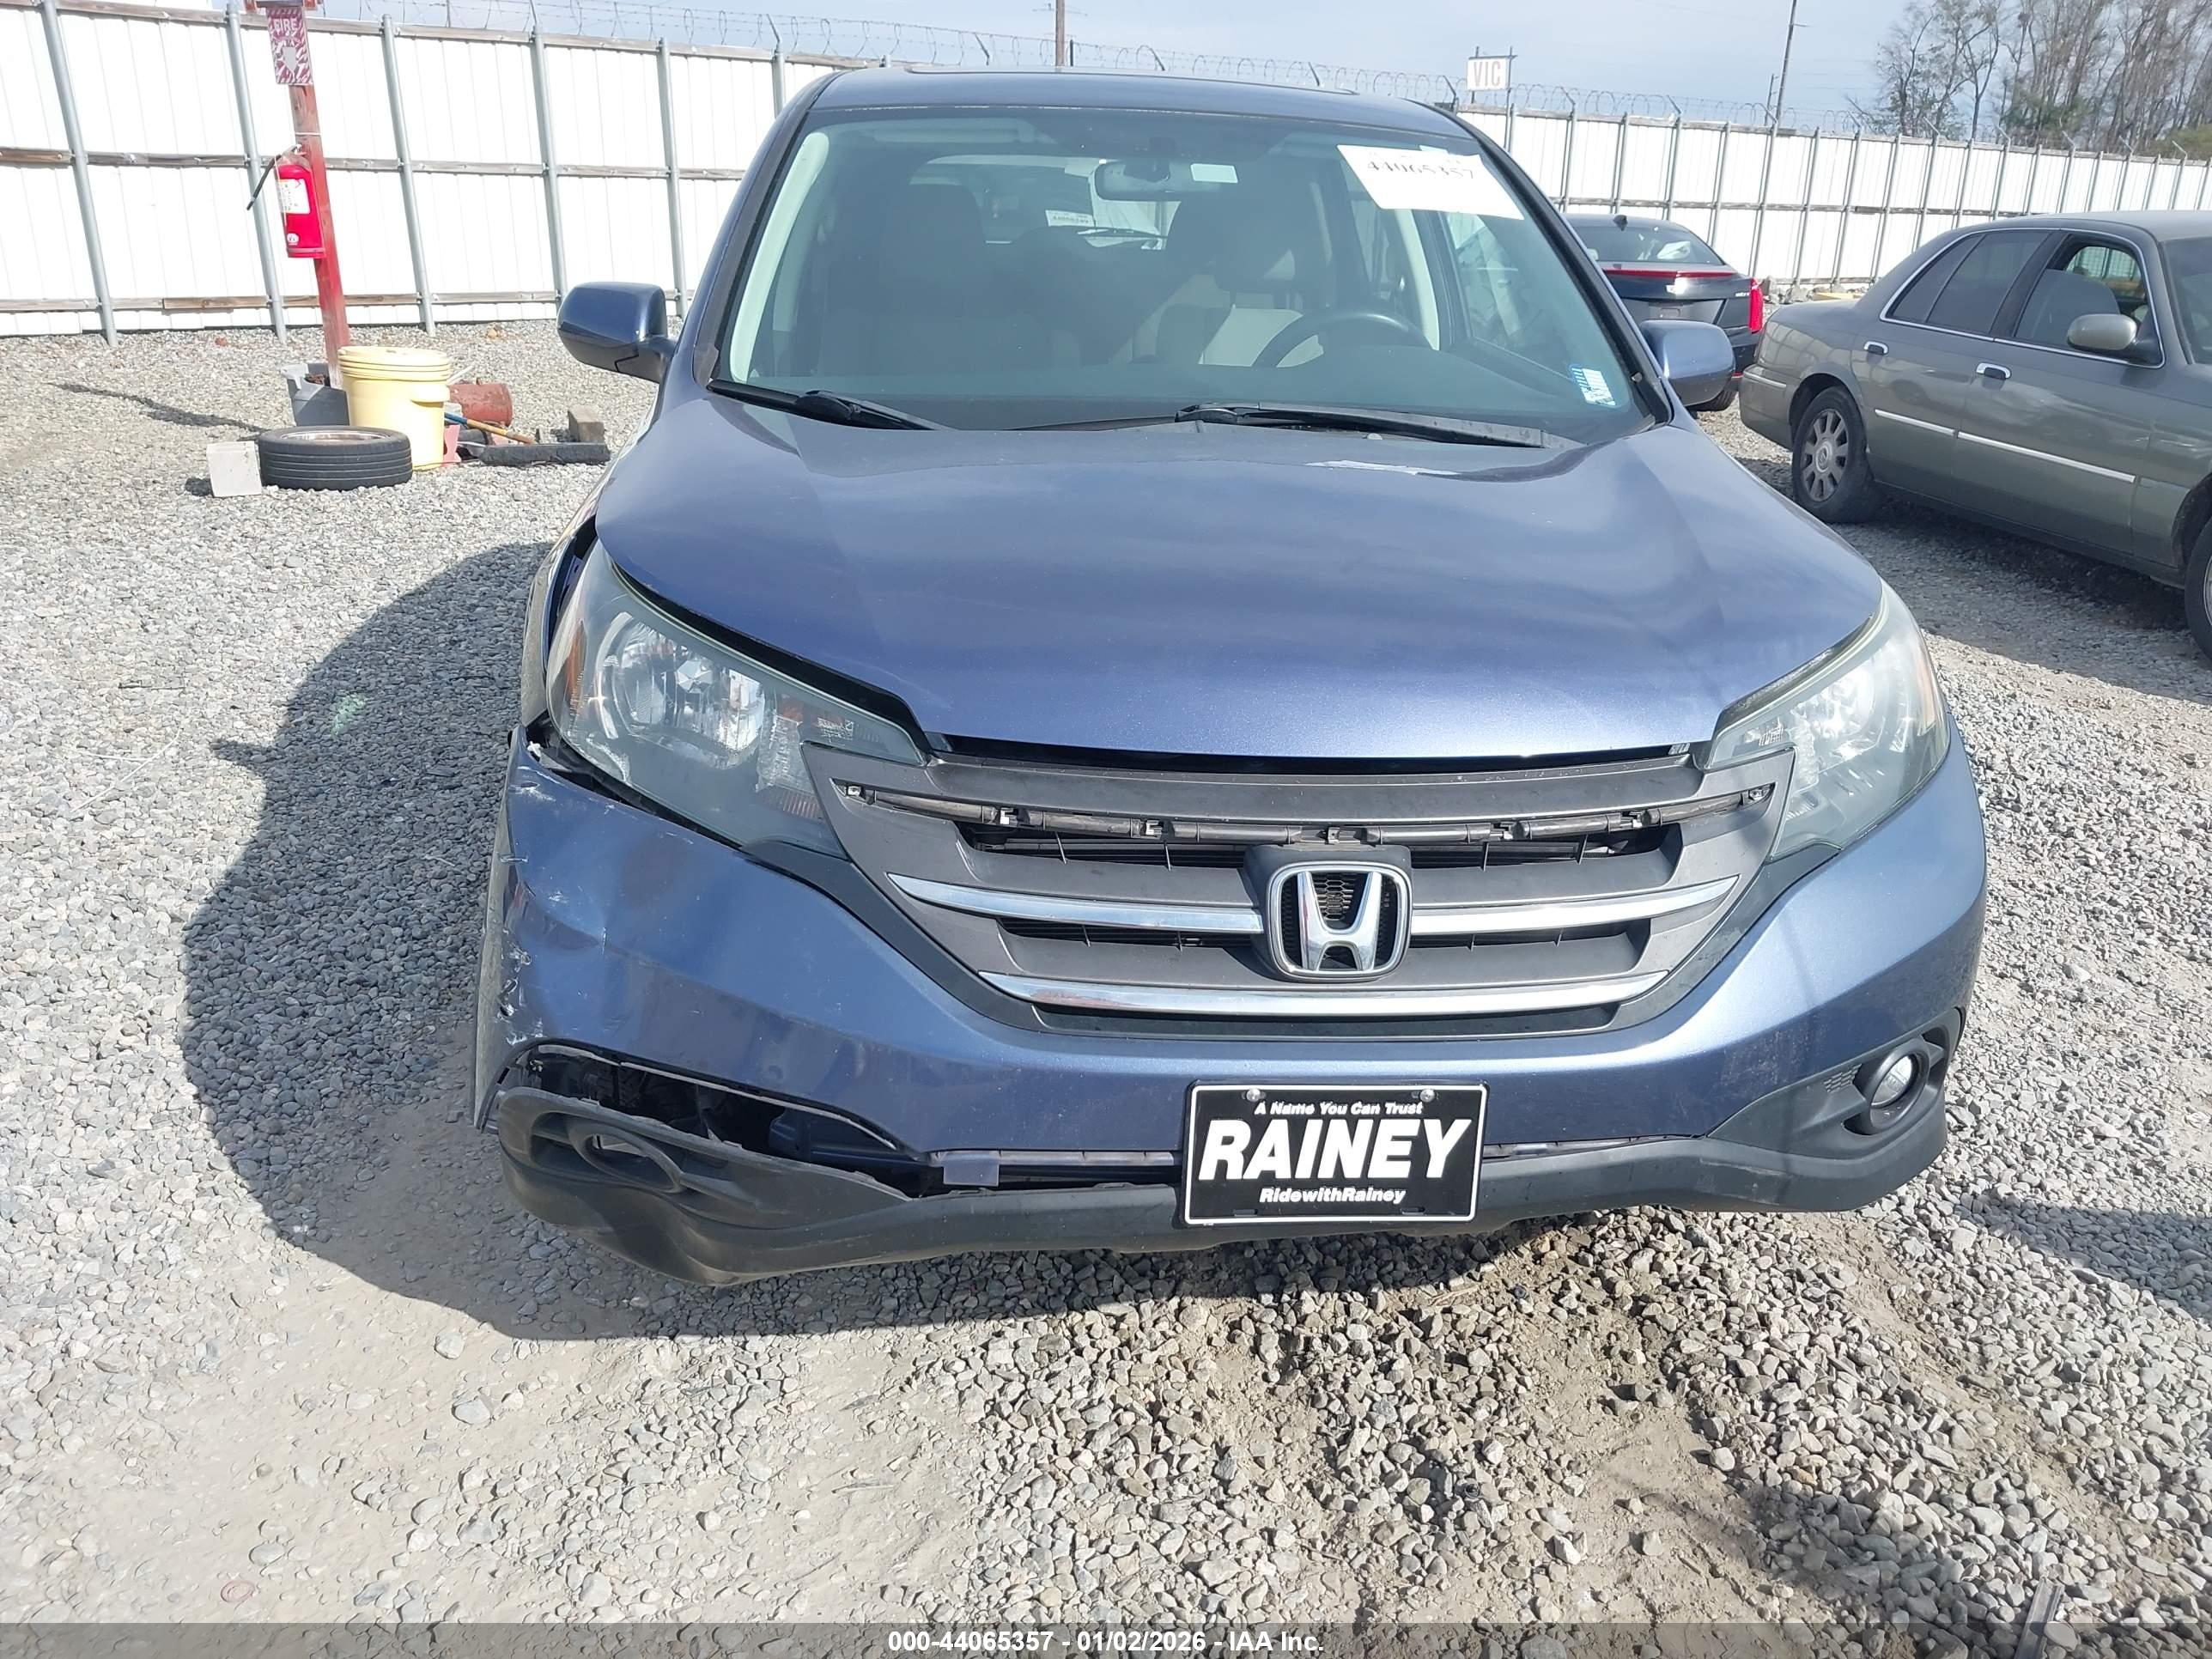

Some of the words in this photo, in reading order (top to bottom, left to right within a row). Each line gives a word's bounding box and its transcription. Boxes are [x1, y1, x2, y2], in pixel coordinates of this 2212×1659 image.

[275, 17, 298, 32] FIRE
[1474, 60, 1501, 87] VIC
[1254, 1101, 1267, 1115] A
[1270, 1101, 1316, 1115] Name
[1320, 1101, 1348, 1115] You
[1351, 1101, 1381, 1115] Can
[1384, 1101, 1424, 1115] Trust
[1198, 1118, 1473, 1182] RAINEY
[1259, 1186, 1407, 1204] RidewithRainey
